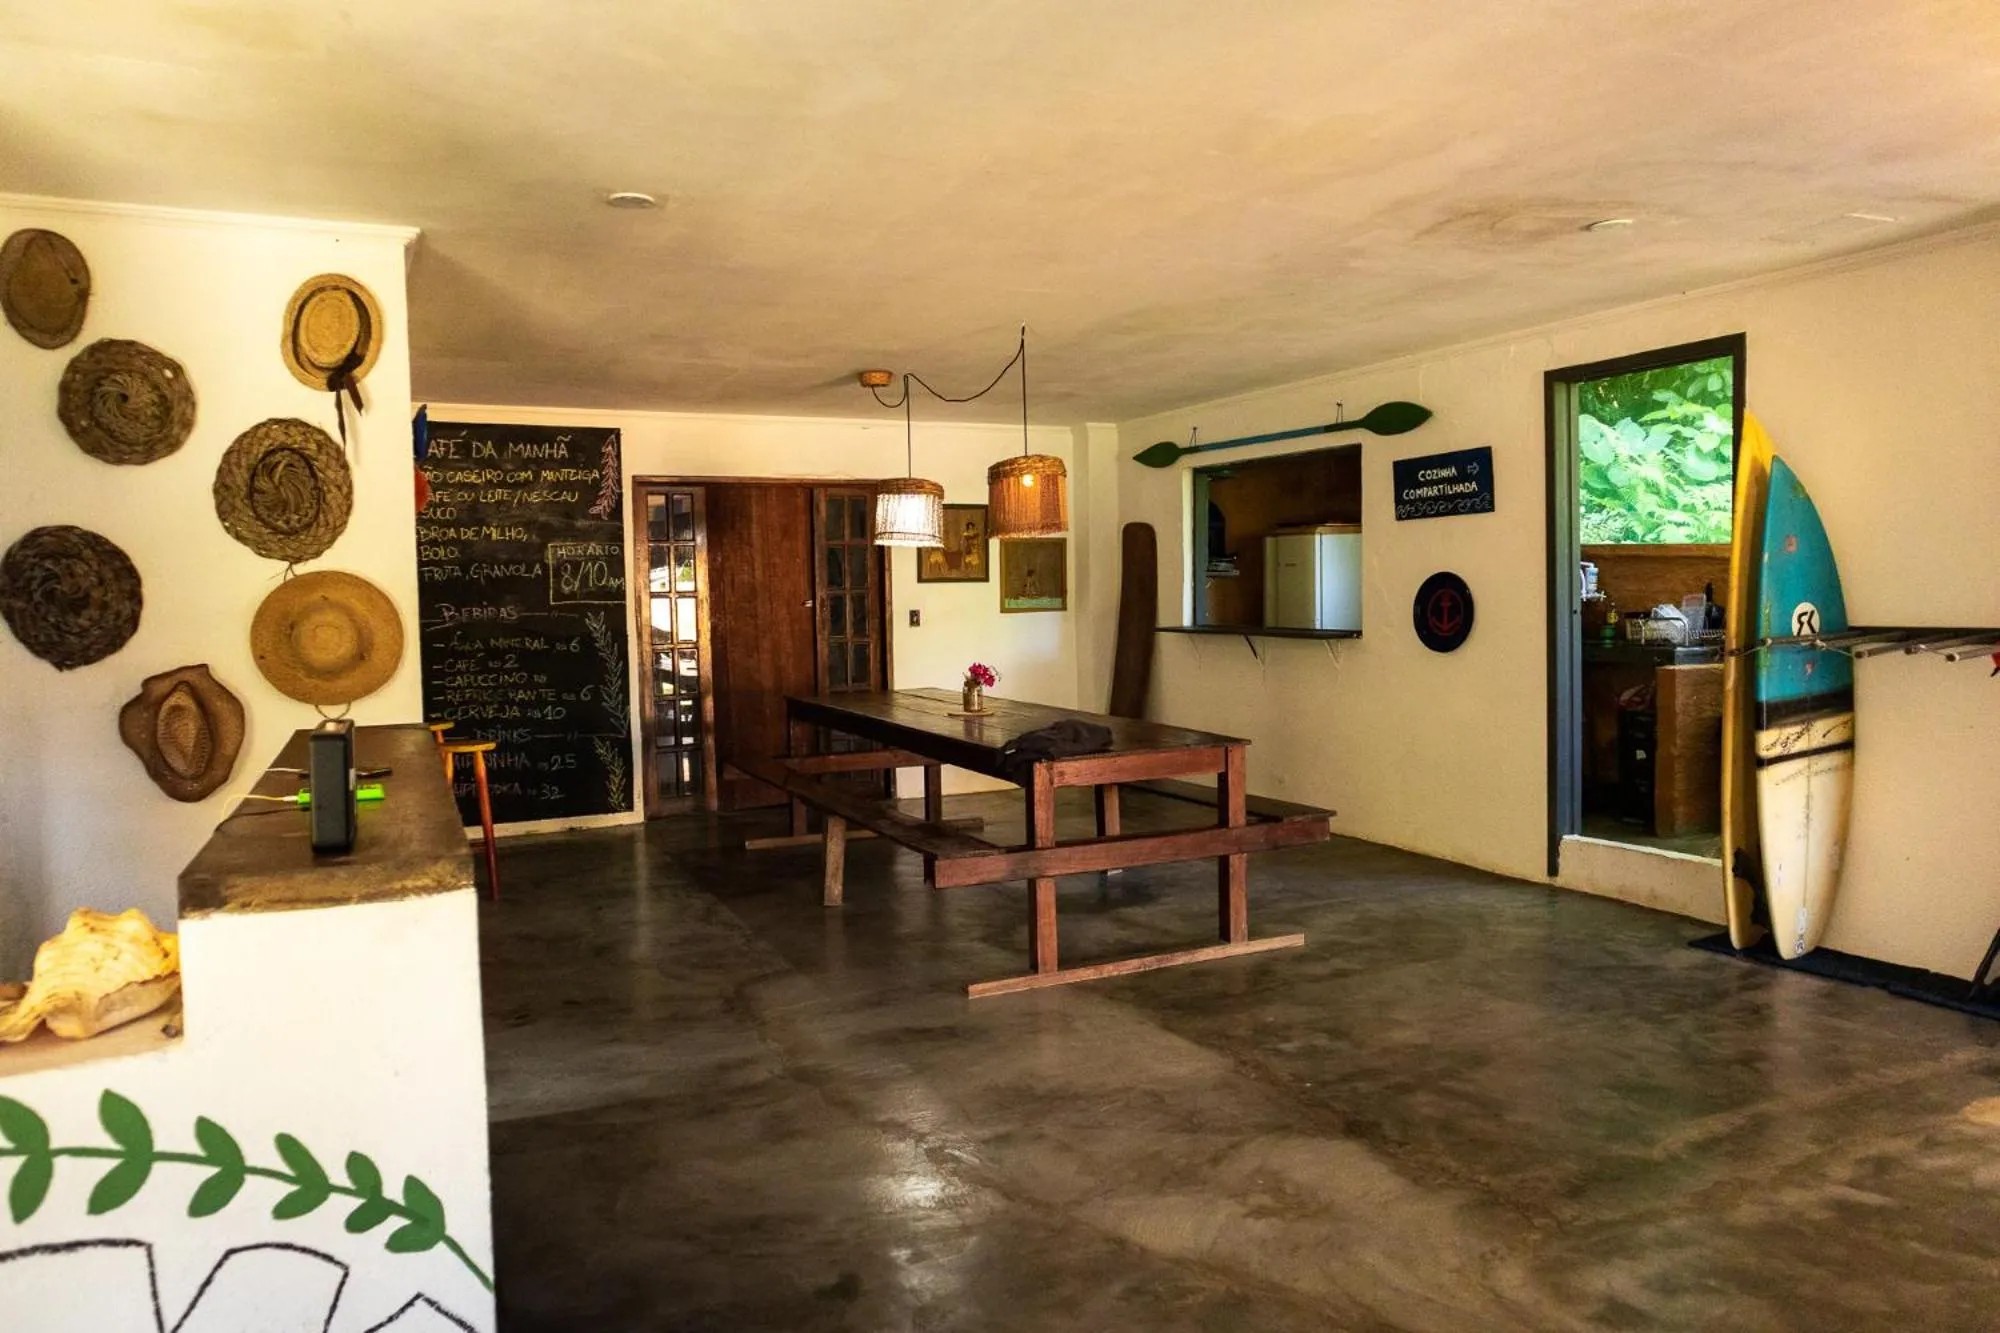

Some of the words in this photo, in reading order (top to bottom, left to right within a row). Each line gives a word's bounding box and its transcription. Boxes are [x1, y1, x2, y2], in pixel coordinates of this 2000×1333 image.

[427, 430, 467, 459] AFÉ
[472, 440, 497, 459] DA
[508, 435, 572, 459] MANHÃ
[421, 465, 444, 483] ÃO
[447, 470, 503, 483] CASEIRO
[507, 472, 533, 482] COM
[541, 465, 600, 485] MANTEIGA
[1418, 465, 1458, 482] COZINHA
[457, 492, 475, 502] OU
[1403, 481, 1478, 500] COMPARTILHADA
[417, 525, 456, 541] BROA
[460, 527, 479, 540] DE
[470, 563, 542, 585] GRANOLA
[436, 602, 519, 624] BEBIDAS
[569, 637, 581, 652] 6
[444, 653, 483, 673] CAFÉ
[499, 654, 519, 669] 2
[444, 672, 528, 687] CAPUCCINO
[580, 684, 595, 701] 6
[443, 704, 521, 721] CERVEJA
[543, 706, 566, 721] 10
[550, 753, 578, 771] 25
[540, 784, 567, 800] 32
